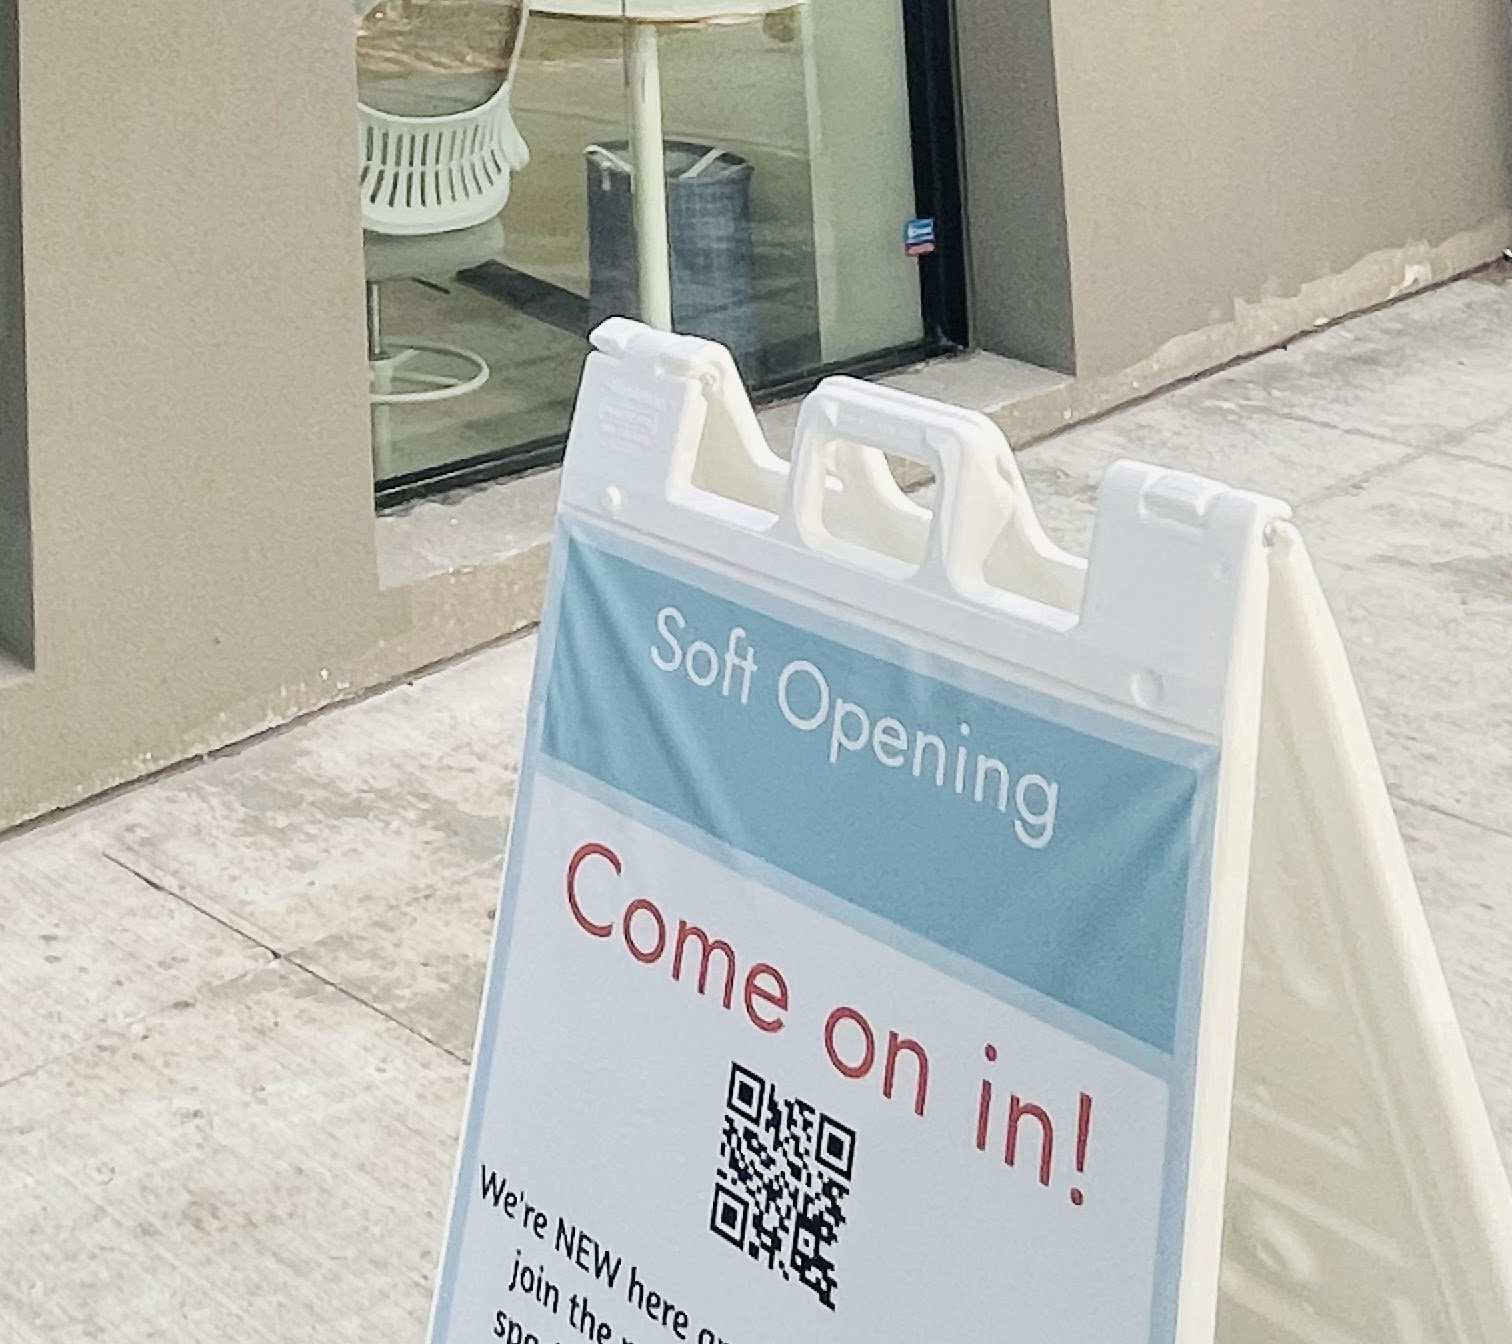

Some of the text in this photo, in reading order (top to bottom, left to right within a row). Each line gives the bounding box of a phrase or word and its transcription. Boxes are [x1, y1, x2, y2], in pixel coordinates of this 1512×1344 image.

[649, 606, 1059, 850] Soft Opening
[565, 841, 1095, 1207] Come on in!
[480, 1163, 548, 1240] We're
[554, 1216, 623, 1289] NEW
[627, 1266, 689, 1341] here
[508, 1248, 560, 1314] join
[568, 1294, 612, 1344] the
